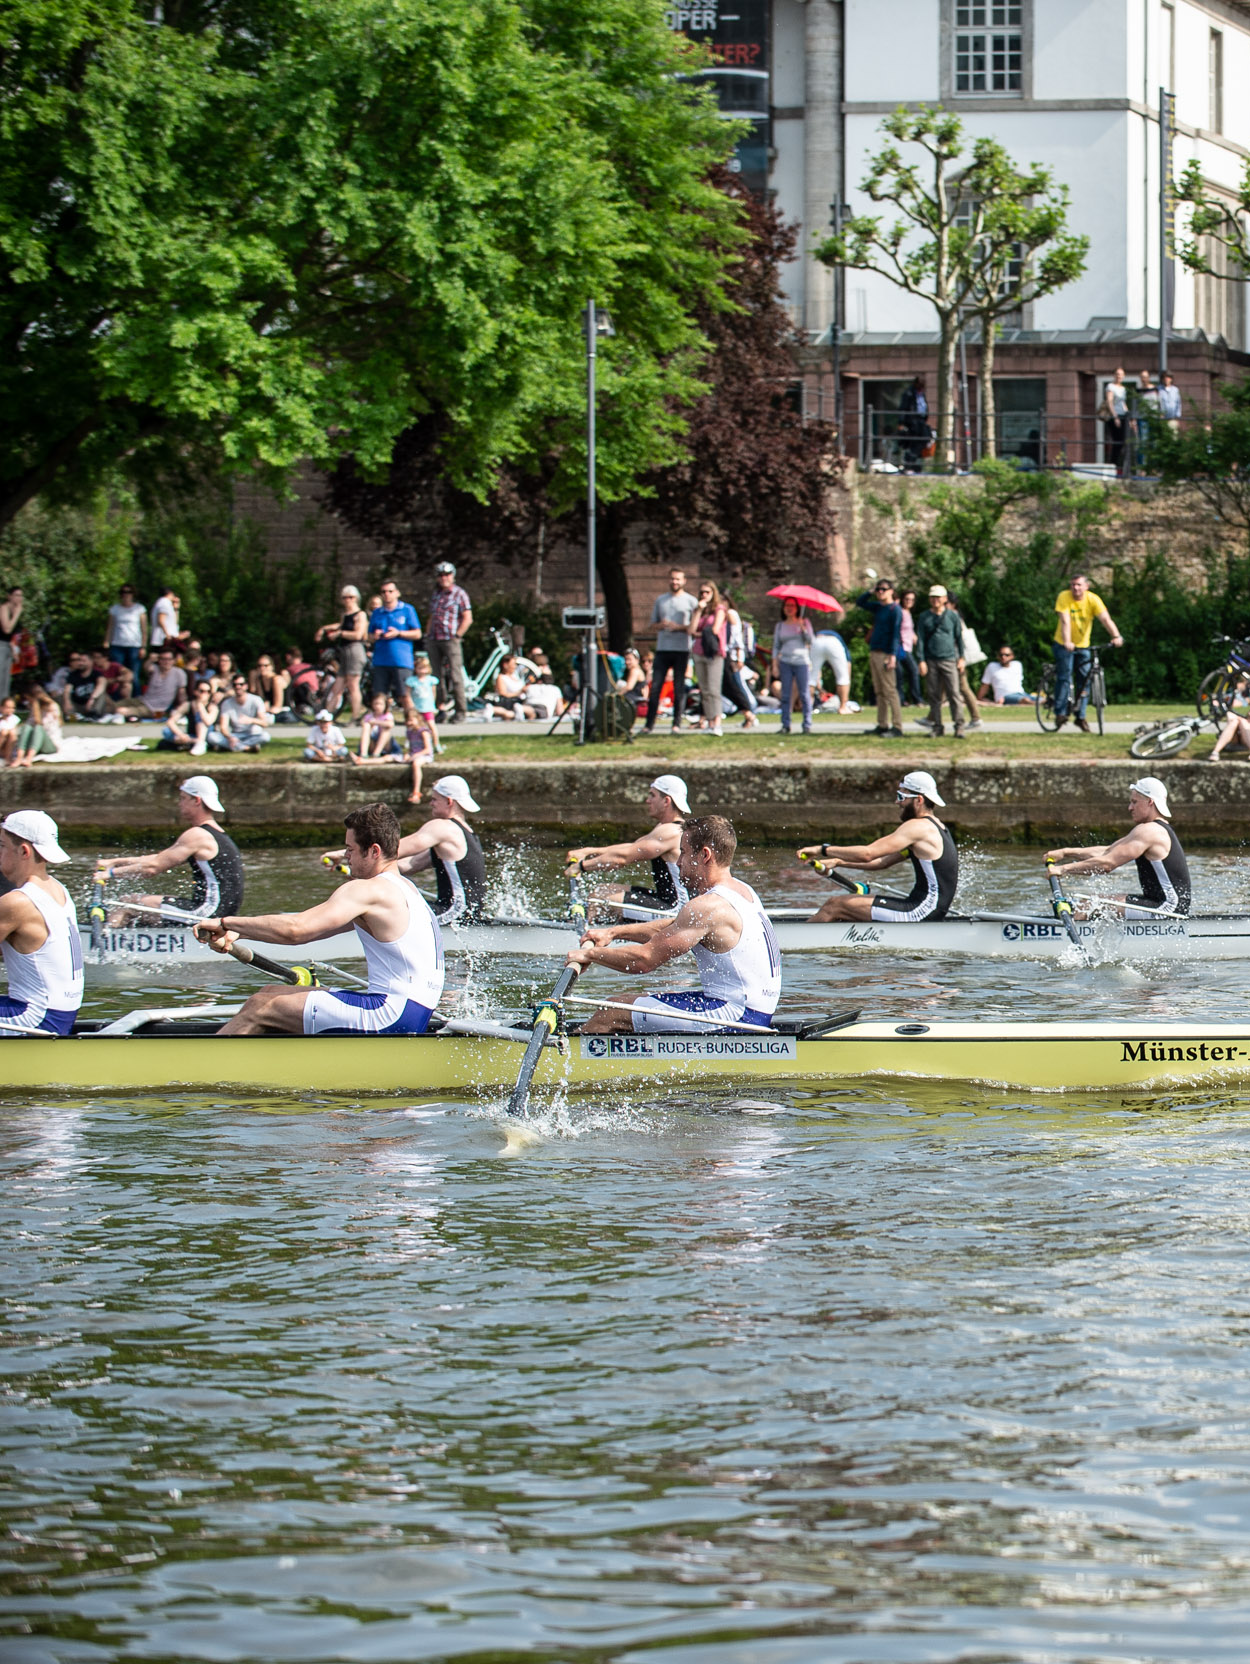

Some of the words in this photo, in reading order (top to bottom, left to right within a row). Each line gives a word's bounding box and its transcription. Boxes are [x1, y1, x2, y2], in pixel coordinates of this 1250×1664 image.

[664, 10, 717, 30] OPER
[1023, 924, 1062, 936] RBL
[611, 1039, 653, 1052] RBL
[658, 1042, 790, 1054] RUDER-BUNDESLIGA
